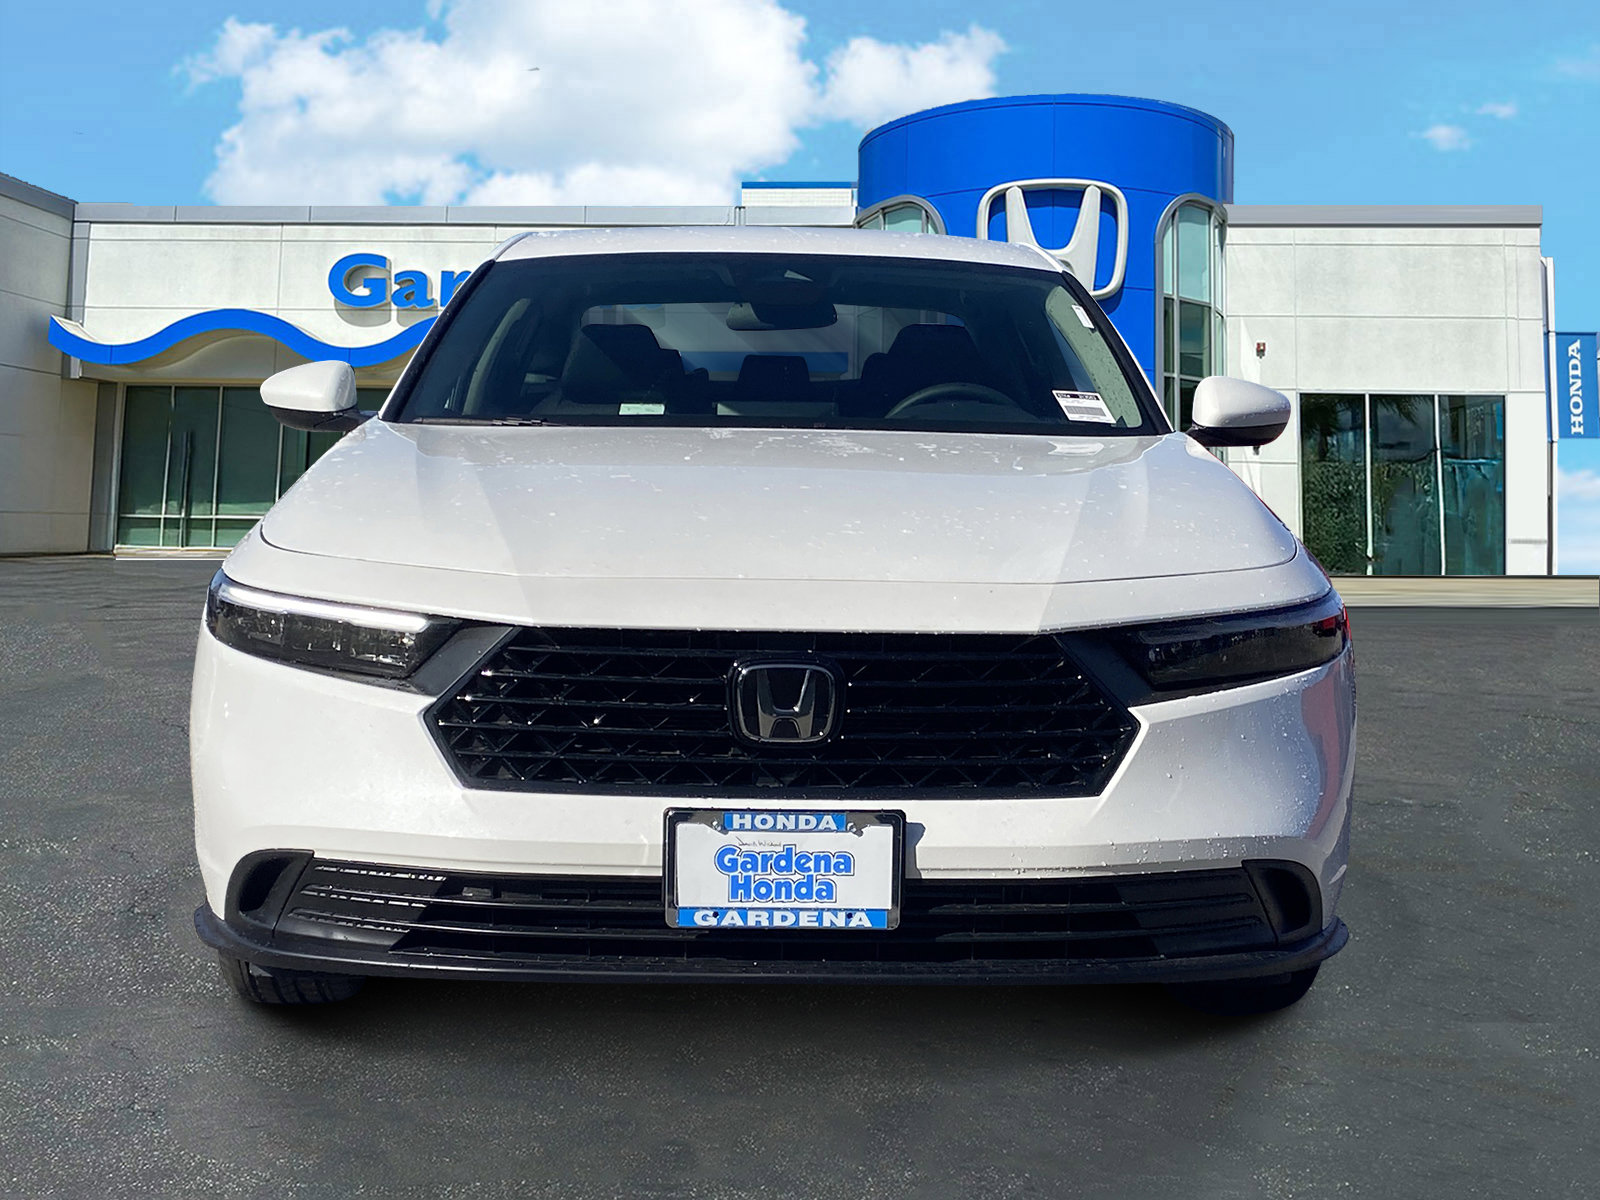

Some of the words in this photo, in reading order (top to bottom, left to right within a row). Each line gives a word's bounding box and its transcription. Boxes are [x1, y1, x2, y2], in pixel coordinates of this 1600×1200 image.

[1568, 339, 1584, 435] HONDA
[732, 813, 839, 831] HONDA
[714, 845, 855, 876] Gardena
[728, 873, 837, 903] Honda
[693, 911, 873, 928] GARDENA
